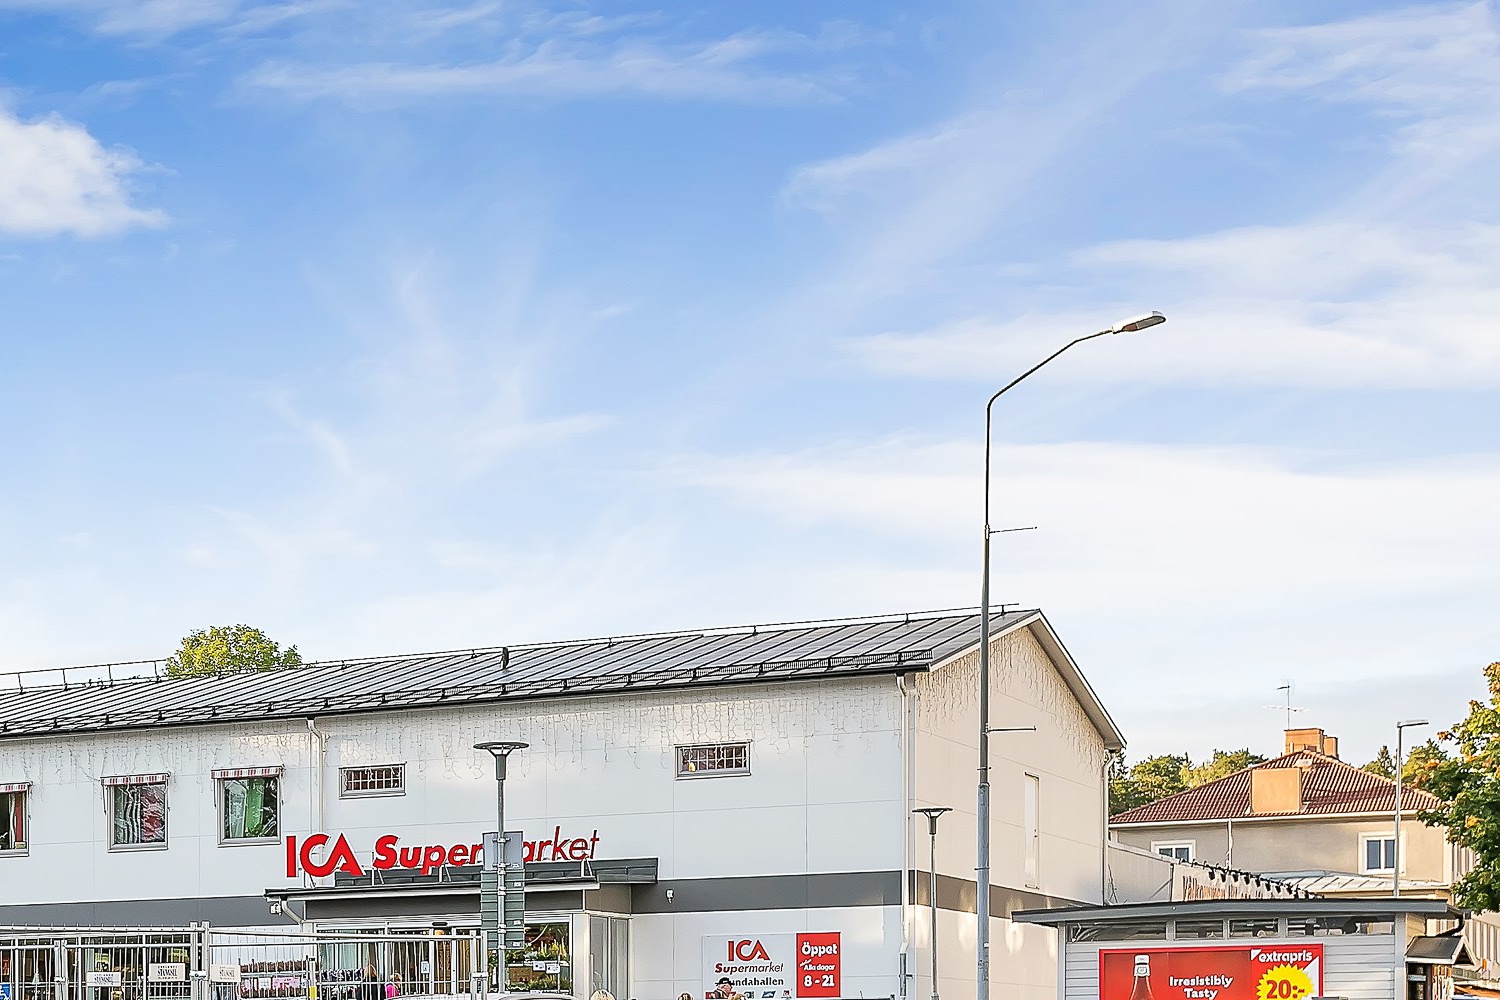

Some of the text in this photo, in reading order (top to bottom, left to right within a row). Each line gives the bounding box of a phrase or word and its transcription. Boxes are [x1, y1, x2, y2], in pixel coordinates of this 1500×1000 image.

[286, 826, 600, 878] ICA Superarket
[728, 940, 770, 962] ICA
[801, 942, 838, 957] Öppet
[1258, 949, 1313, 964] extrapris
[715, 962, 784, 975] Supermarket
[804, 975, 813, 987] 8
[821, 974, 835, 987] 21
[1169, 974, 1234, 988] Irresistibly
[1184, 987, 1219, 1000] Tasty
